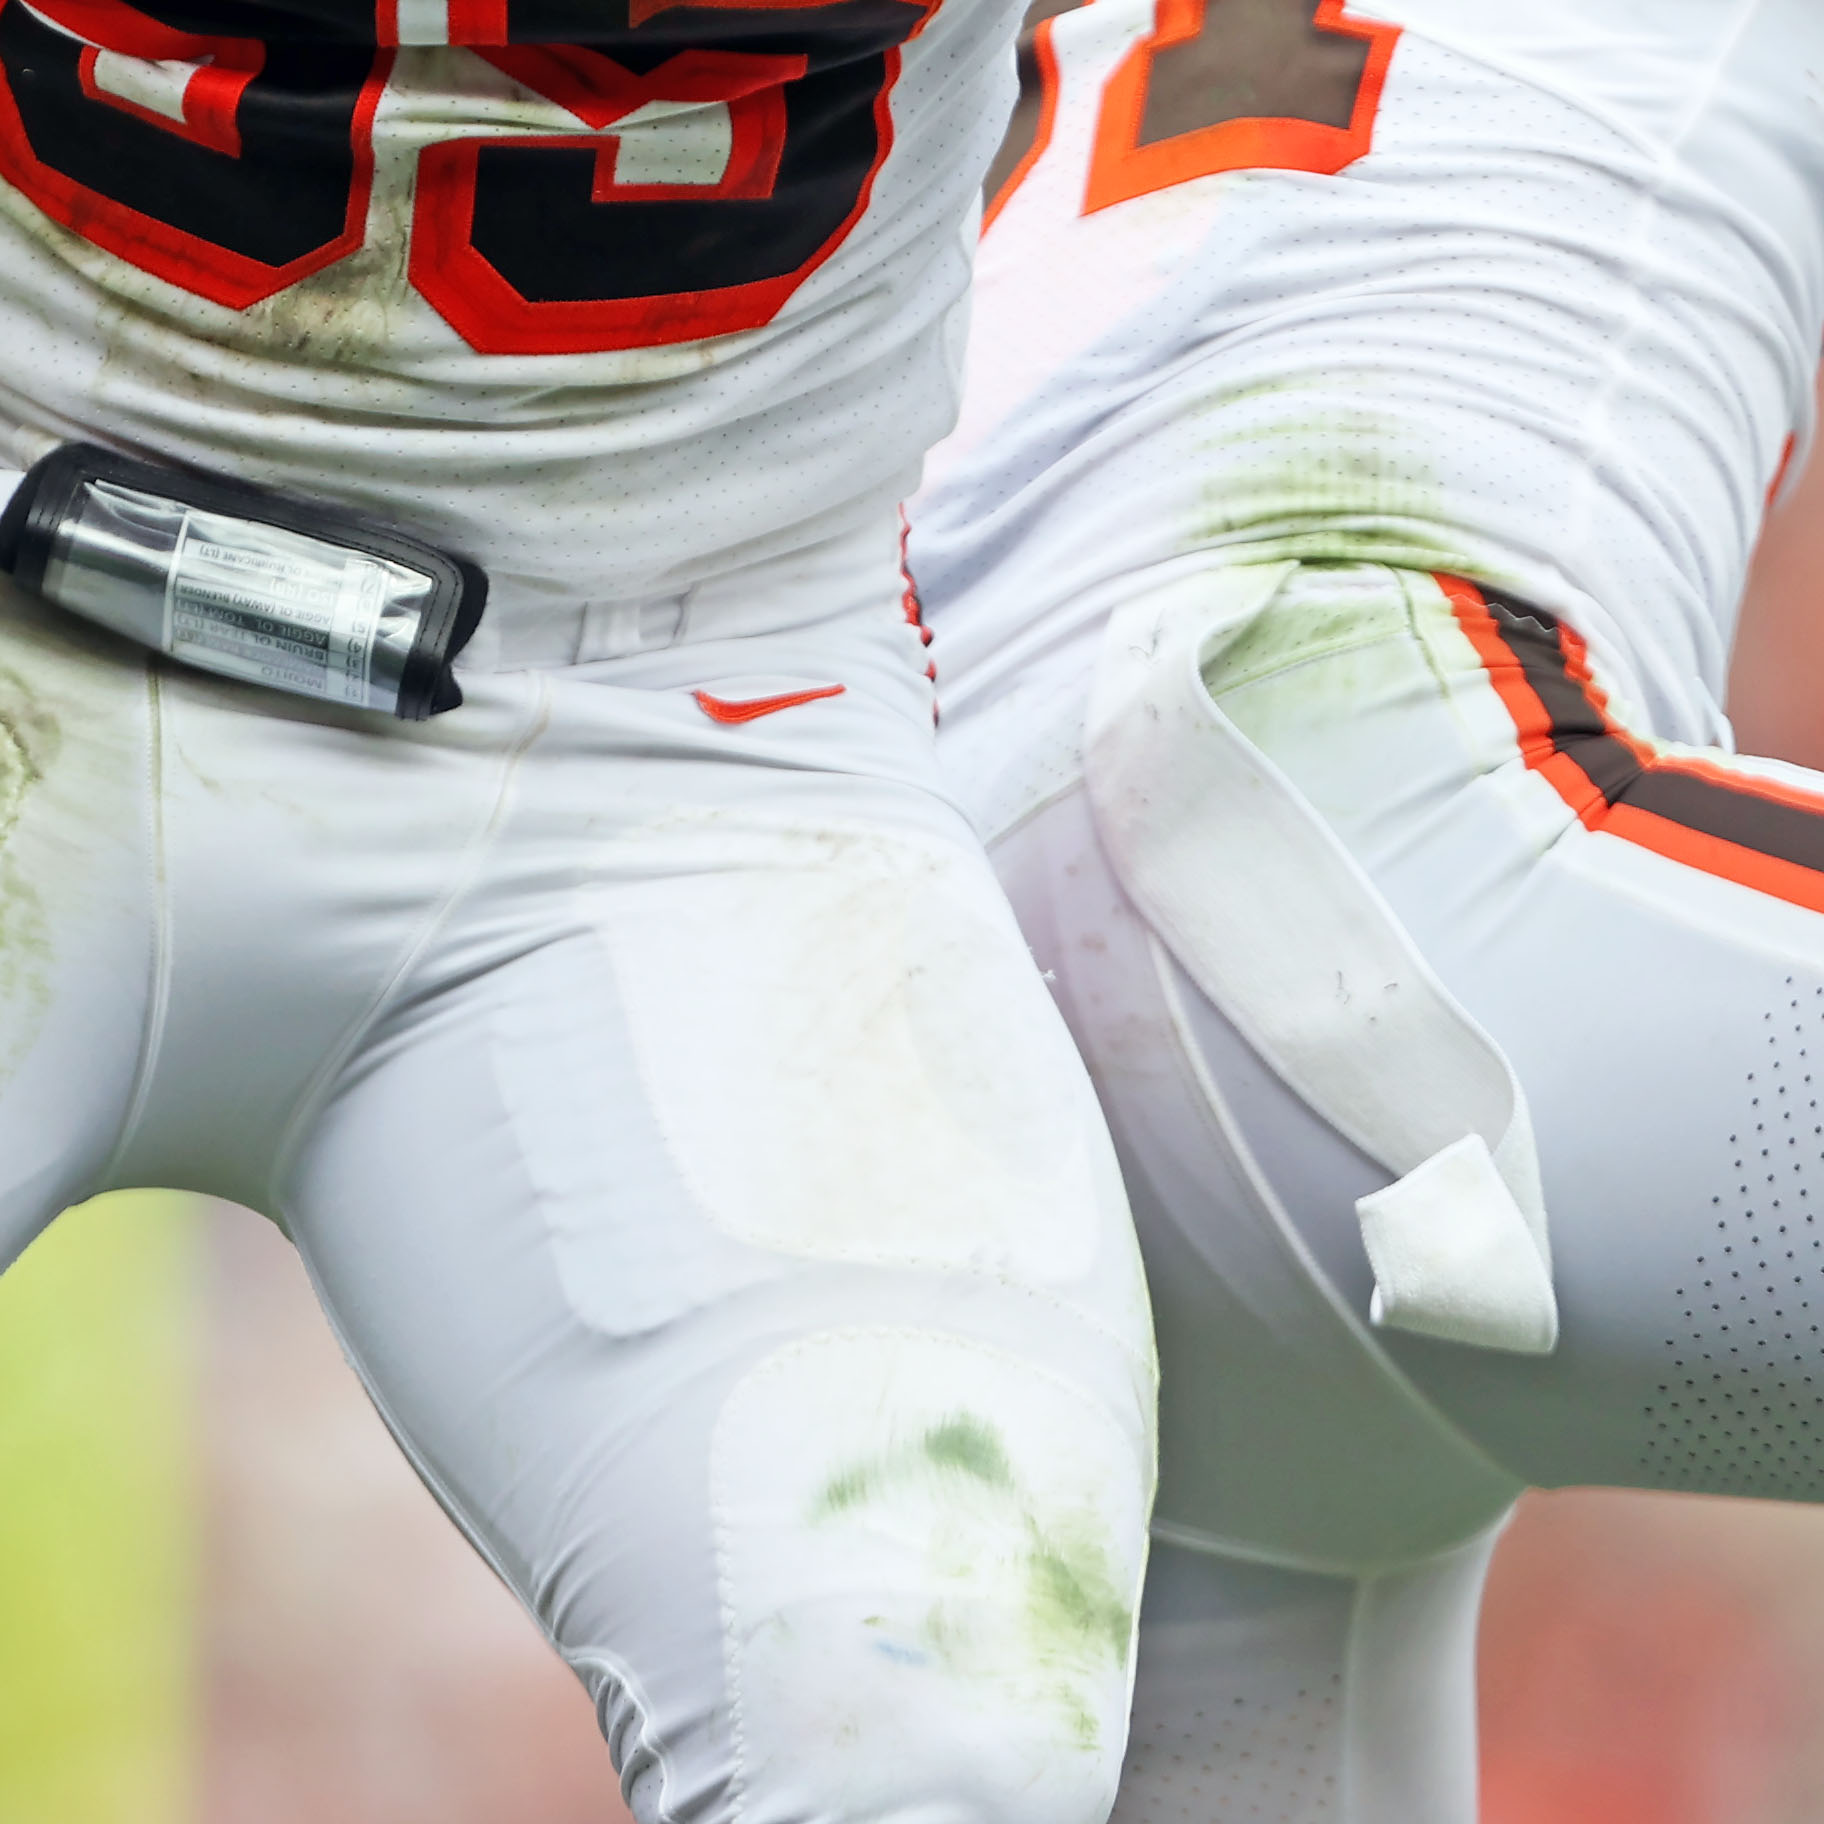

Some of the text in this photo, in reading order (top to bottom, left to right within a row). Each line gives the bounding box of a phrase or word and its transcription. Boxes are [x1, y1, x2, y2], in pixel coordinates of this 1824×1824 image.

[231, 592, 276, 614] (AWAY)
[274, 639, 325, 660] BRUIN
[346, 637, 363, 654] 4)
[344, 656, 359, 669] 3)
